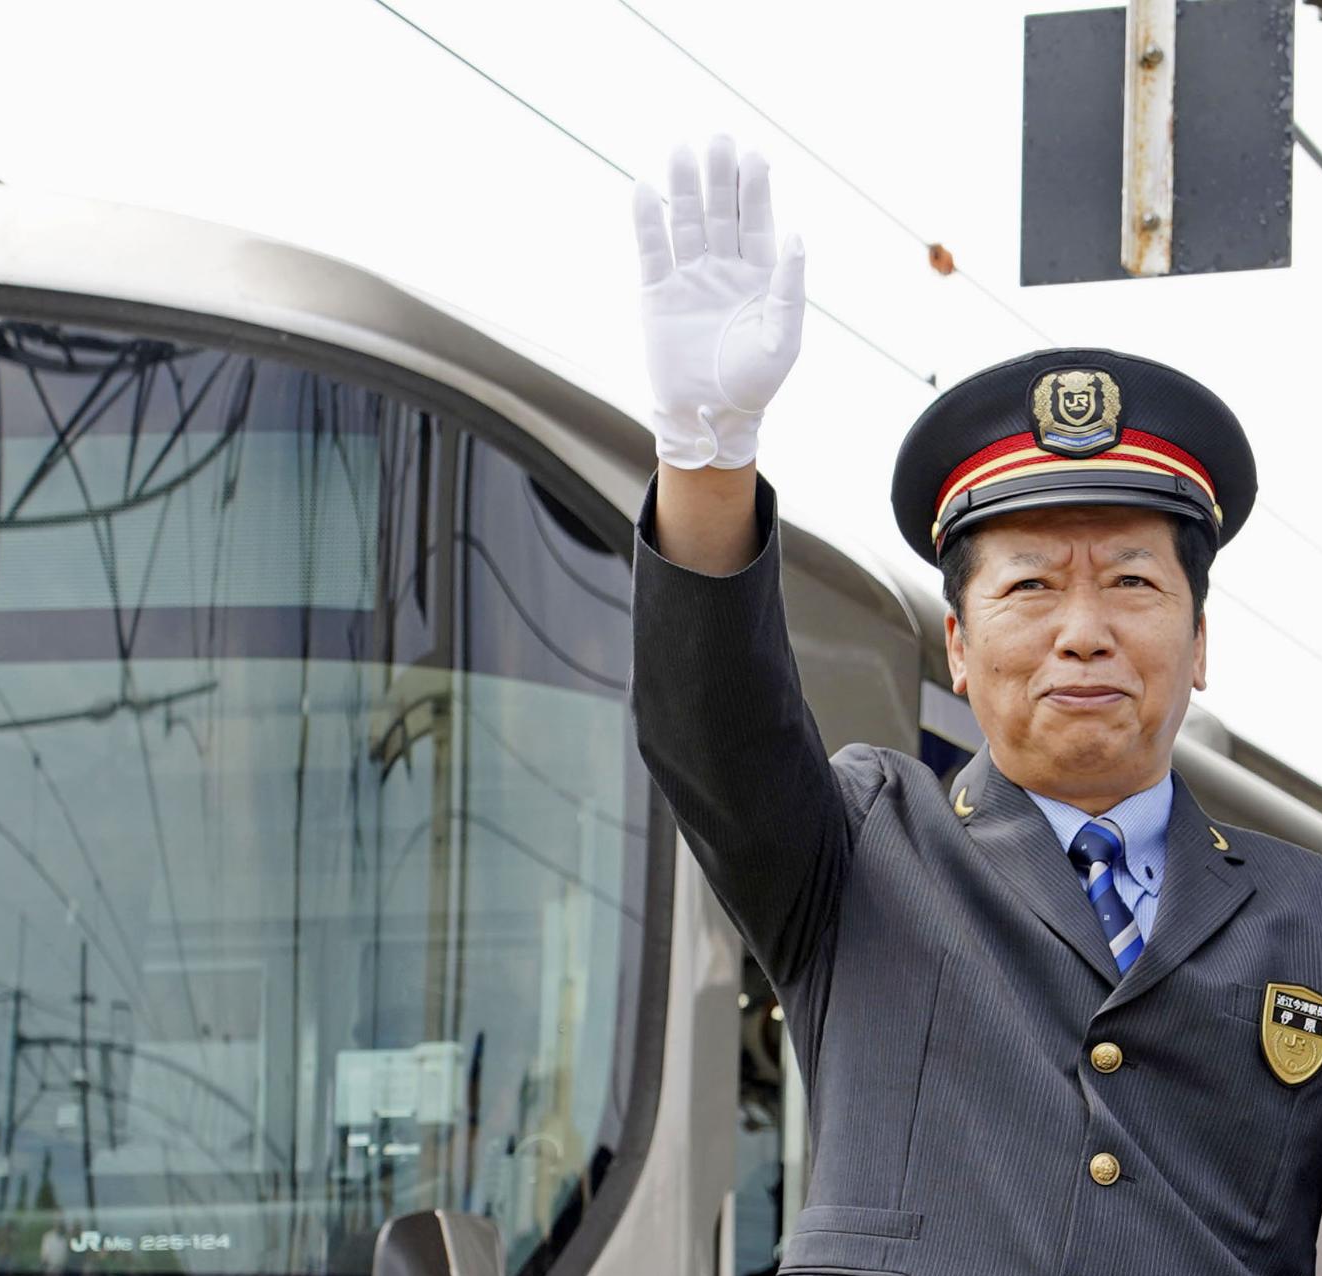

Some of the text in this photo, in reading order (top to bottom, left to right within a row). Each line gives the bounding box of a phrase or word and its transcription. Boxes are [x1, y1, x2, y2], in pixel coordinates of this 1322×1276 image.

[1064, 394, 1089, 408] JR
[70, 1230, 102, 1253] JR
[139, 1233, 231, 1251] 225-124
